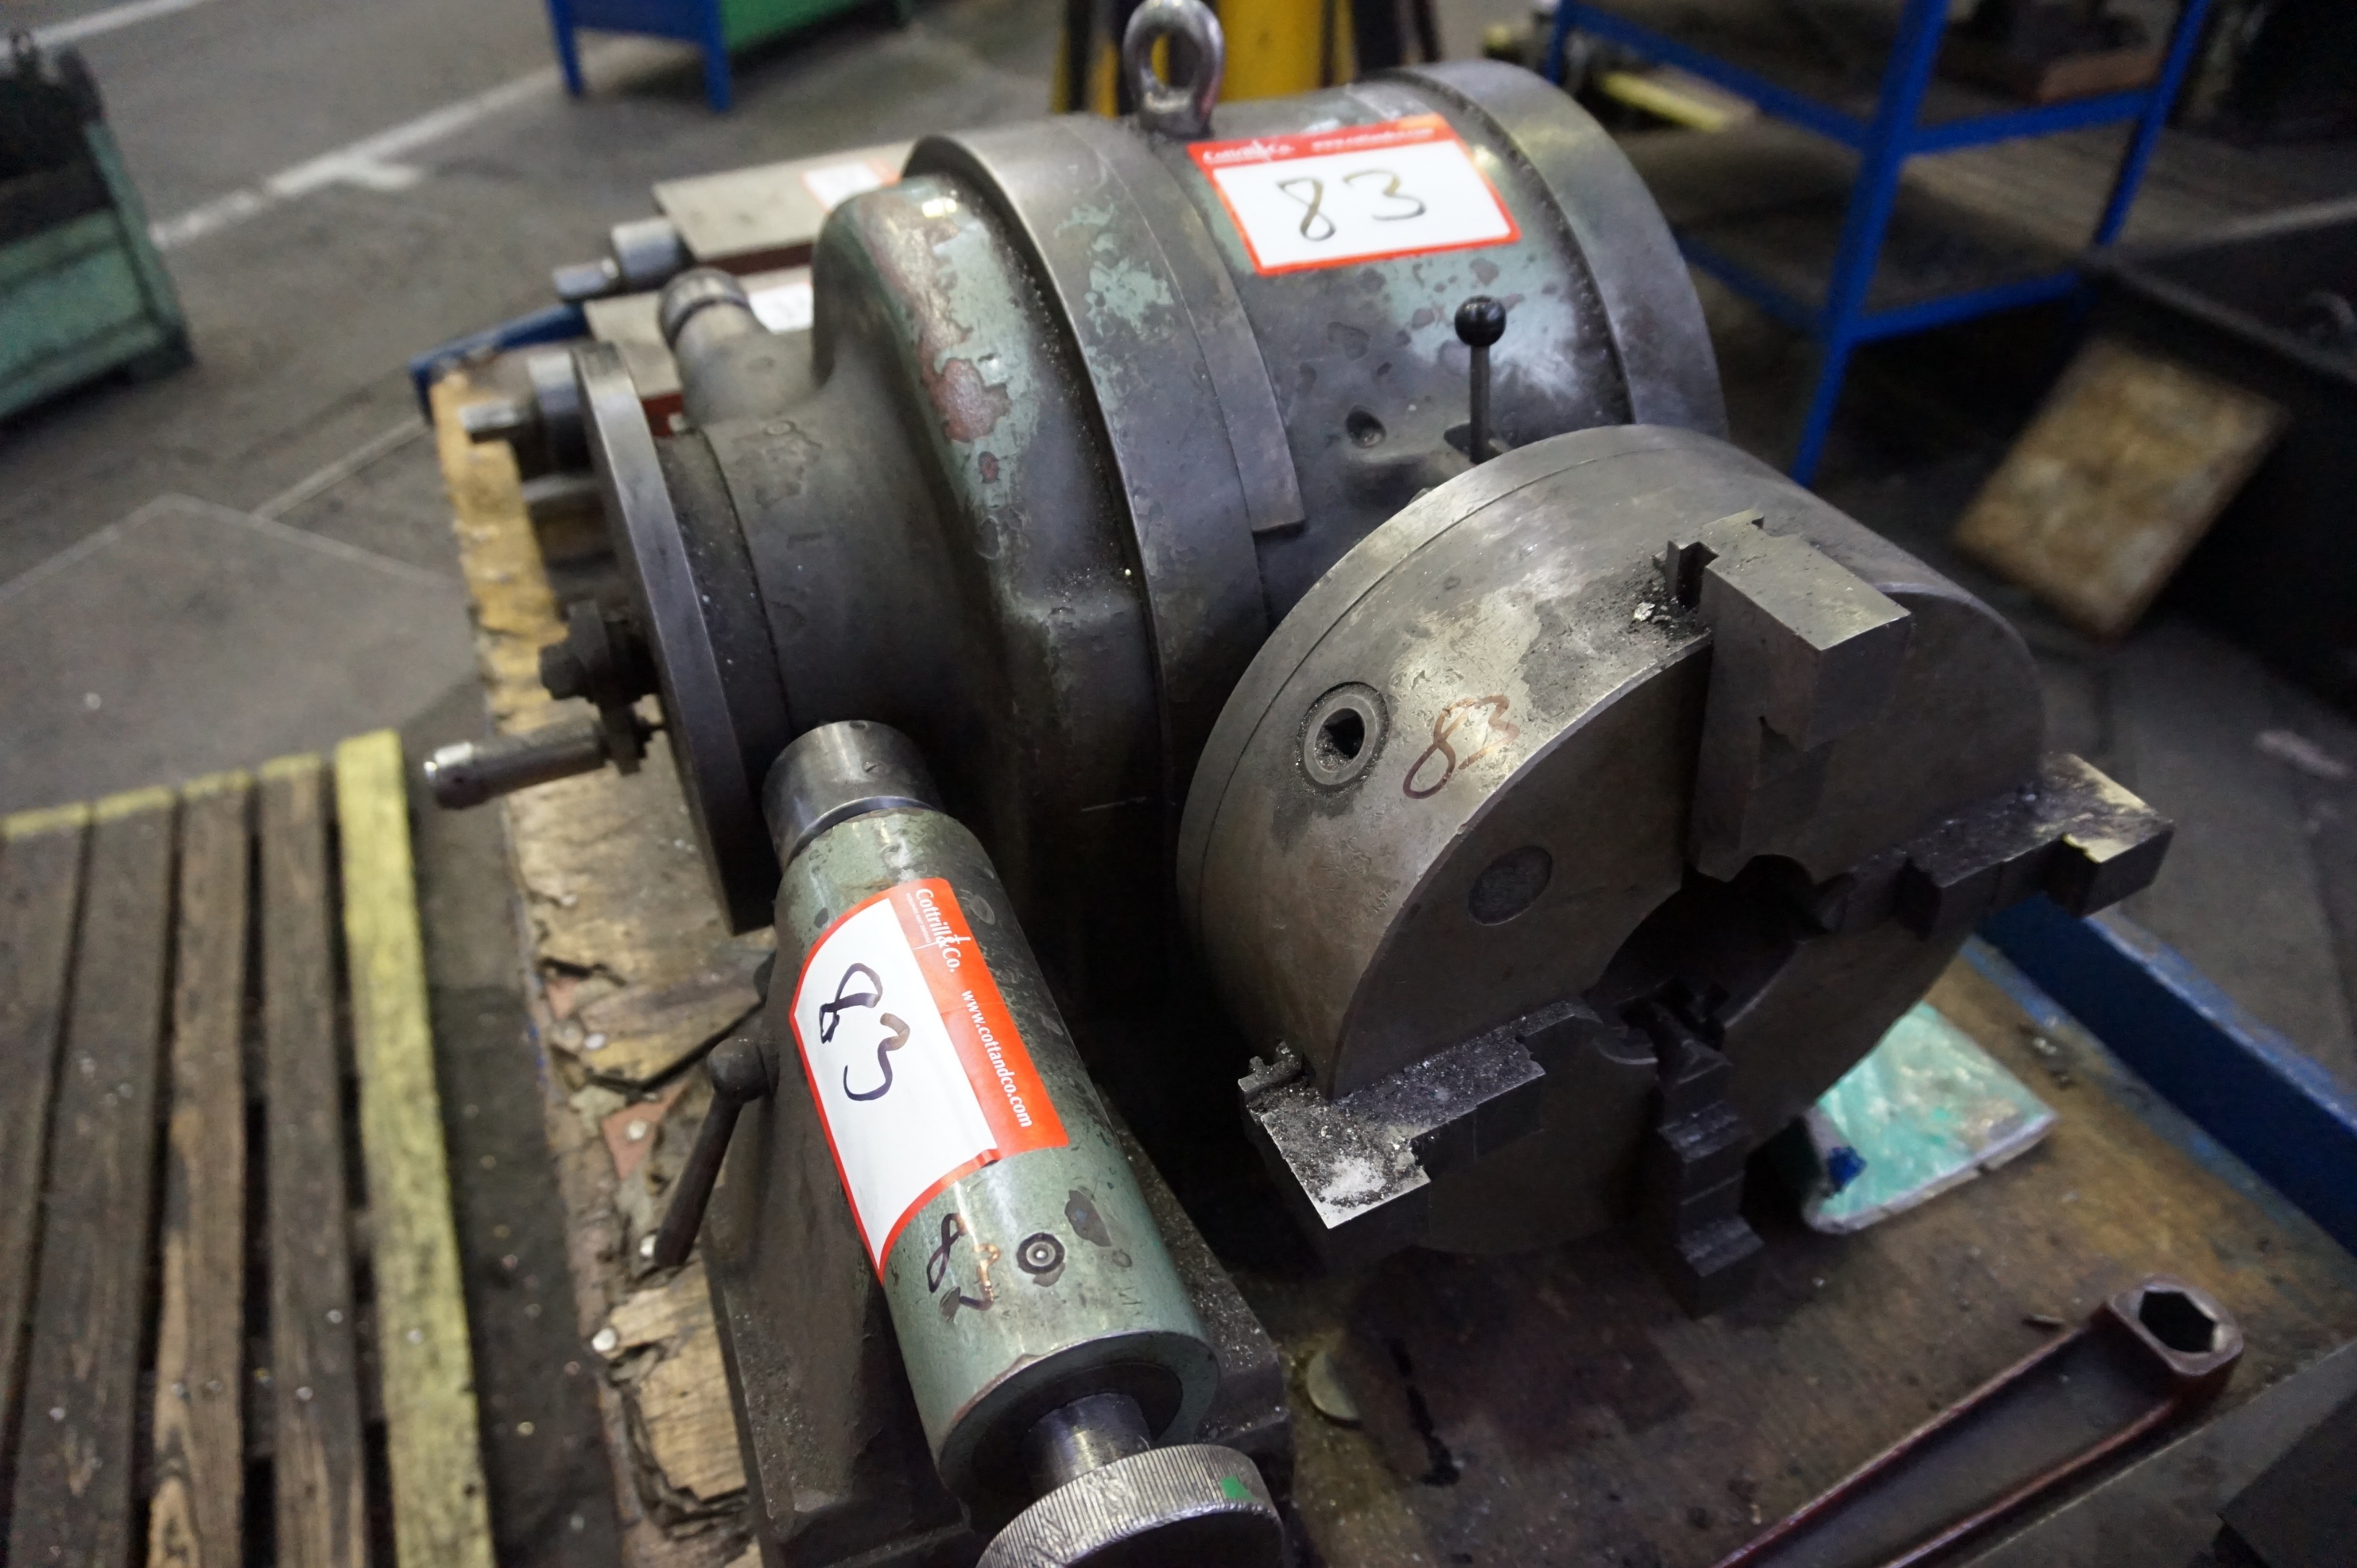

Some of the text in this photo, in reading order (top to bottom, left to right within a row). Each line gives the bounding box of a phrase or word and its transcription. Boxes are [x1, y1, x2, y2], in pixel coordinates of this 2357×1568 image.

[1275, 169, 1427, 242] 83
[1403, 694, 1520, 799] 83
[820, 962, 911, 1102] 83
[961, 990, 1033, 1128] www.cottandco.com
